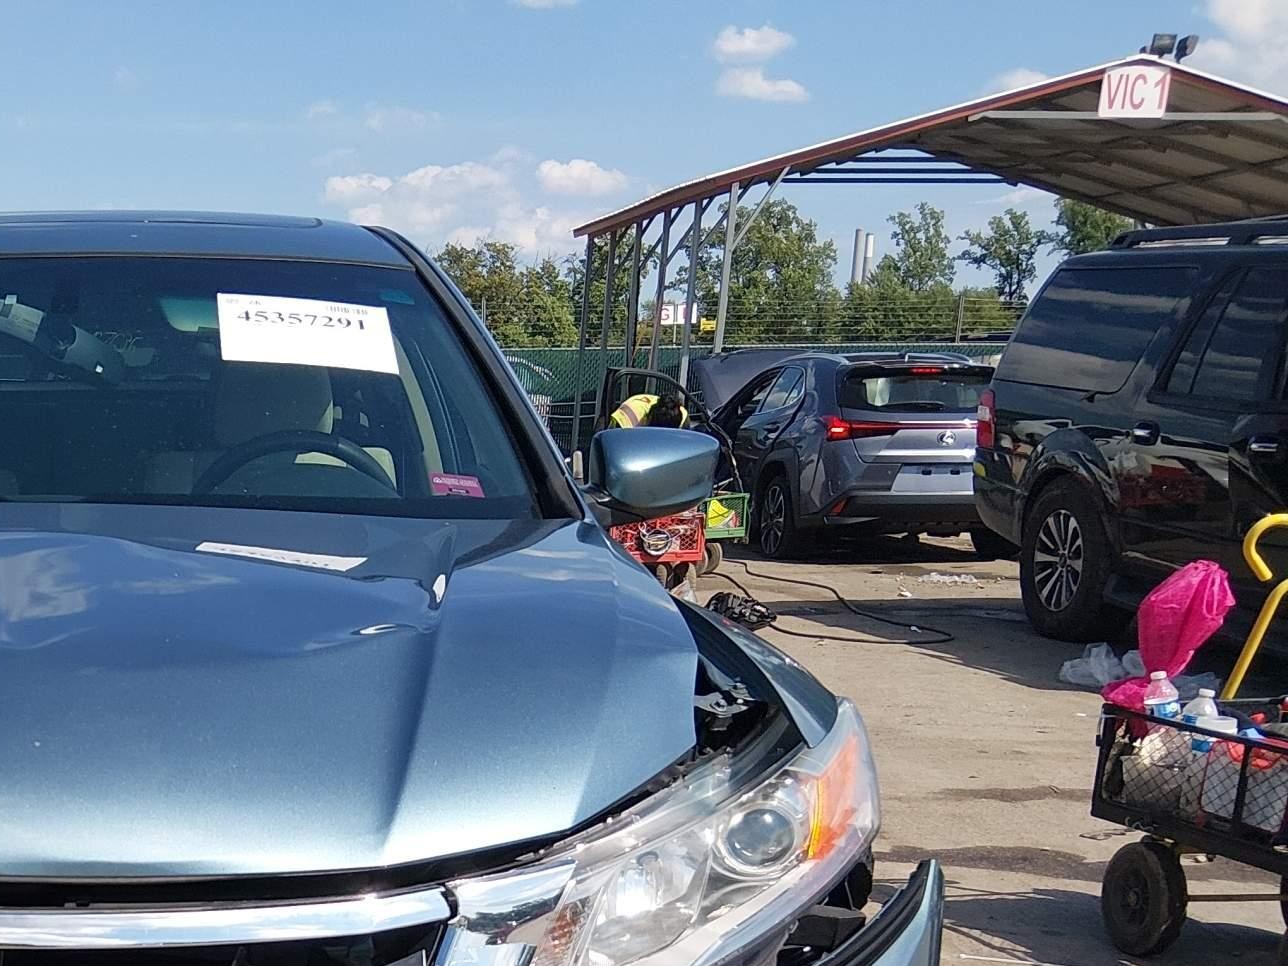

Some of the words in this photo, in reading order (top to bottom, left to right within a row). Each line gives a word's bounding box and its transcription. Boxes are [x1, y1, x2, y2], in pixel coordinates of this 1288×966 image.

[1107, 74, 1148, 110] VIC
[1154, 73, 1168, 110] 1
[237, 310, 365, 331] 45357291
